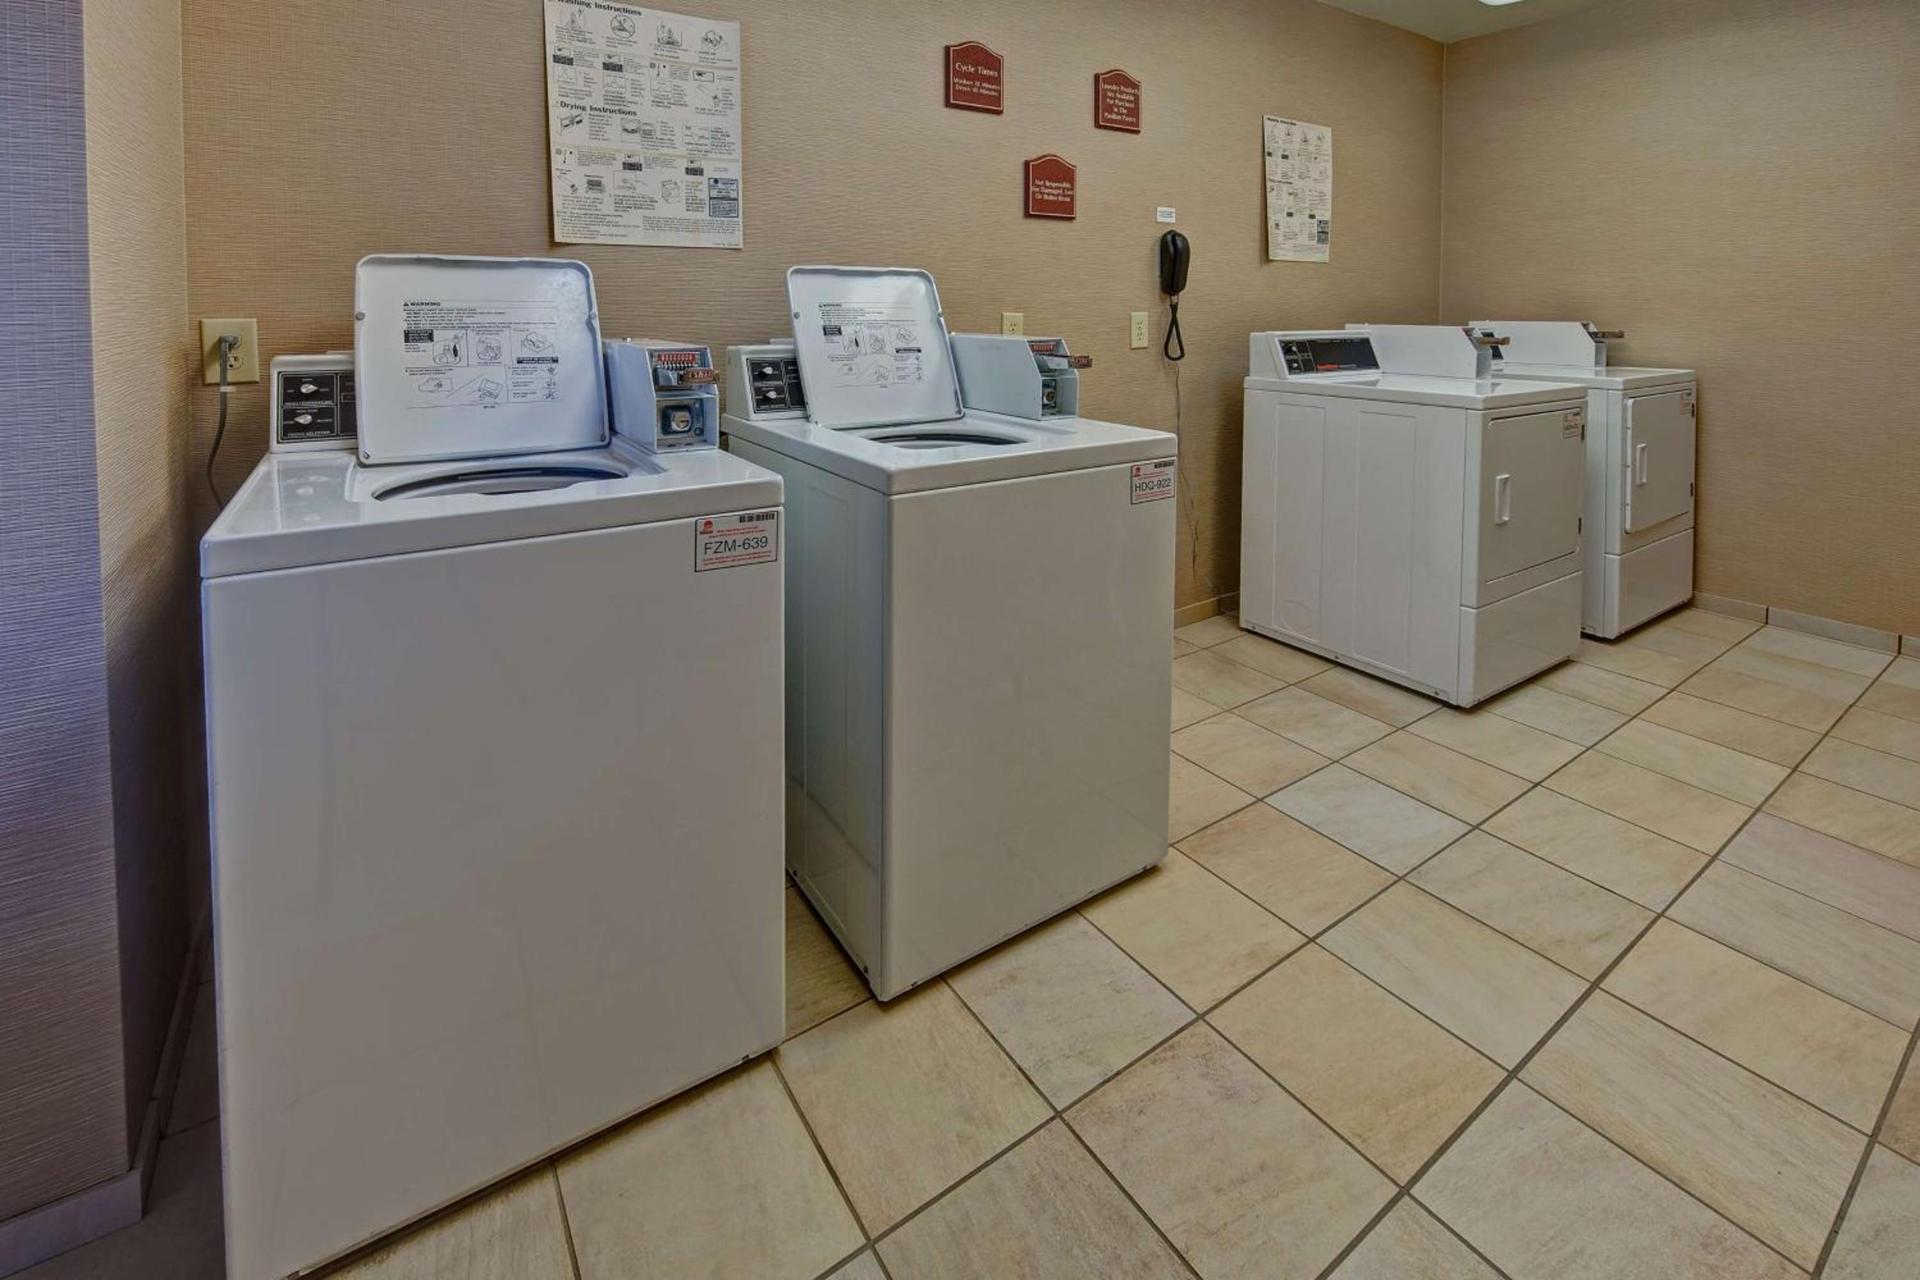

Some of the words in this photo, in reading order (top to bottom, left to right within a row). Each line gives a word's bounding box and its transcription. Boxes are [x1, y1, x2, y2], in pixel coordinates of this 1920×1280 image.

[594, 2, 642, 16] Instructions
[955, 62, 975, 73] Cycle
[977, 66, 998, 77] Times
[560, 100, 586, 111] Drying
[589, 105, 637, 116] Instructions
[704, 535, 768, 555] FZM-639
